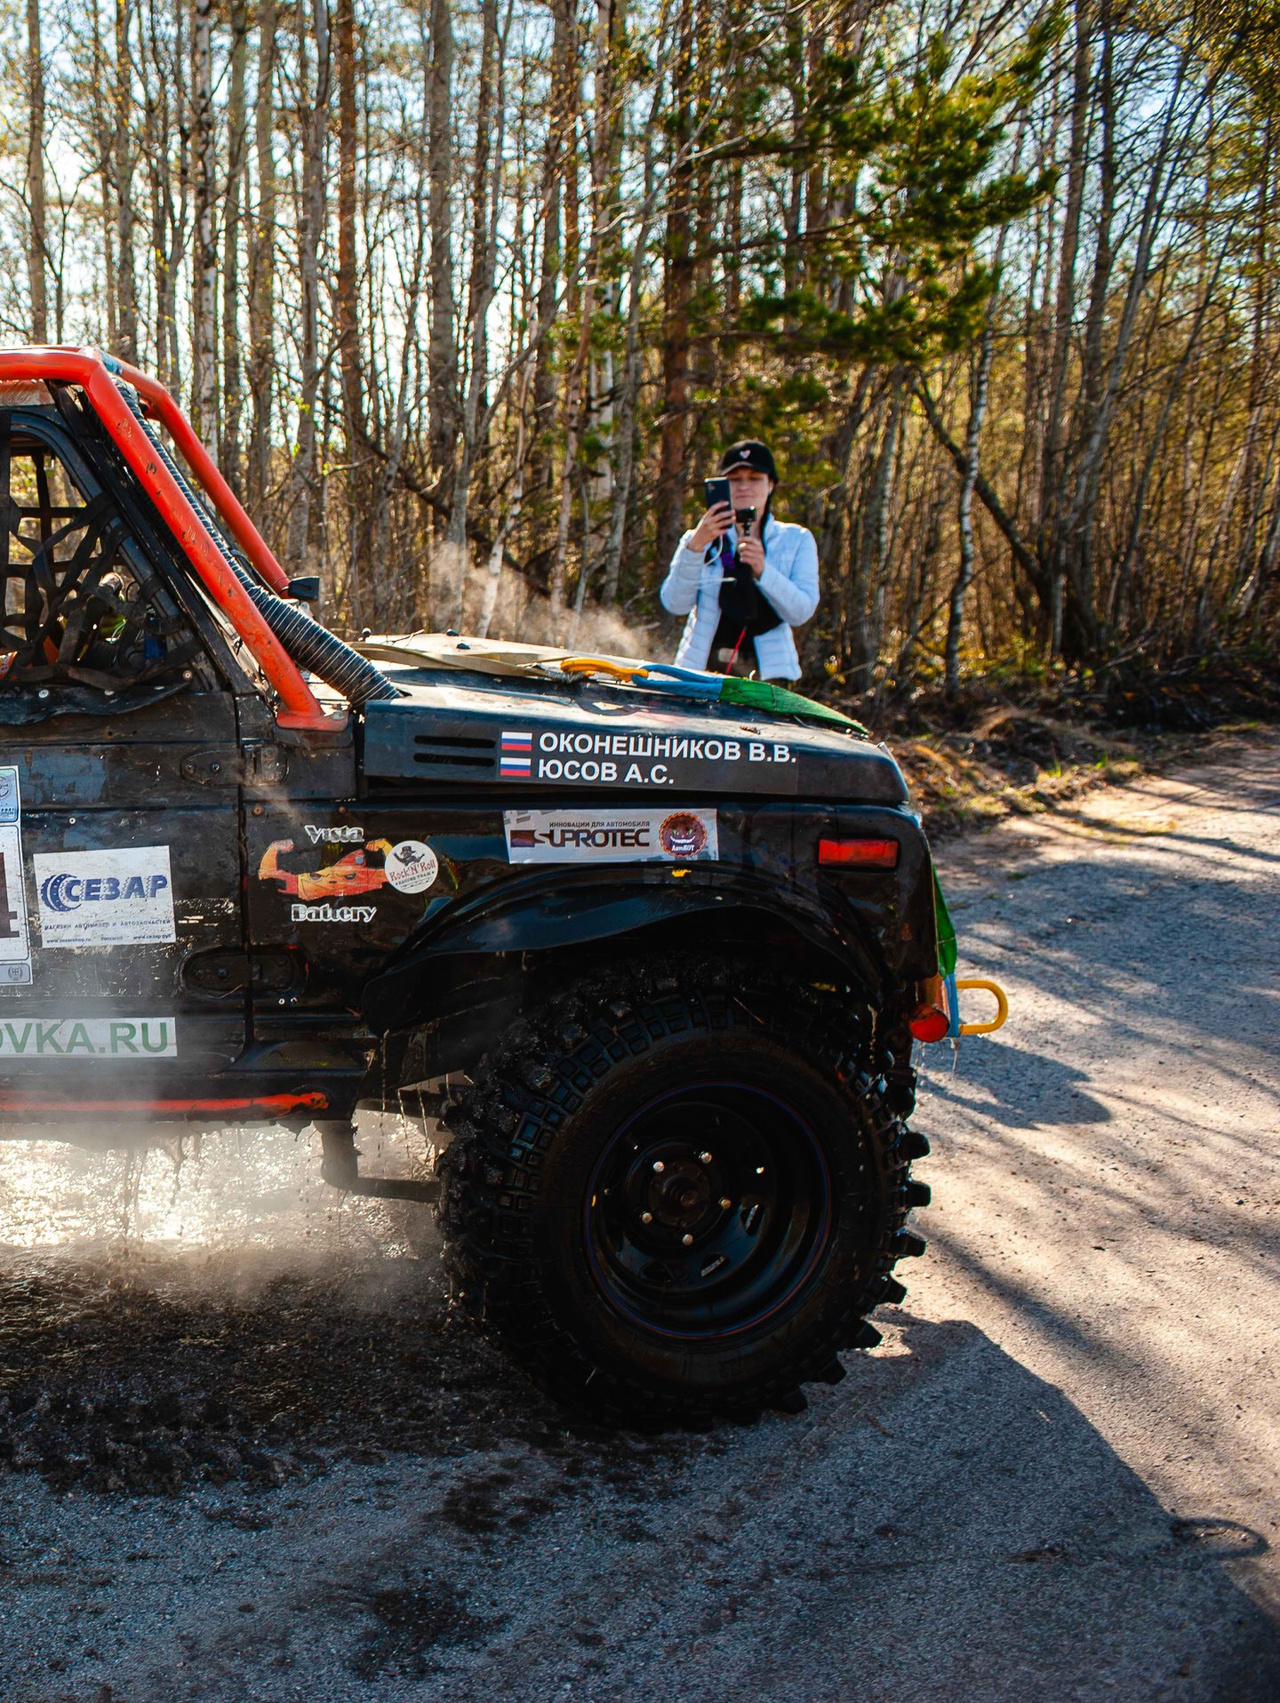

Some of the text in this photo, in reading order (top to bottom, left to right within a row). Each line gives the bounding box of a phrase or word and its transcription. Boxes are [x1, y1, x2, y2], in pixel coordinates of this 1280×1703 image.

[539, 732, 797, 763] ОКОНЕШНИКОВ В.В.
[538, 759, 674, 784] ЮСОВ А.С.
[304, 825, 365, 844] Vista
[532, 829, 650, 848] SUPROTEC
[65, 875, 168, 902] СЕЗАР
[291, 903, 377, 923] Battery
